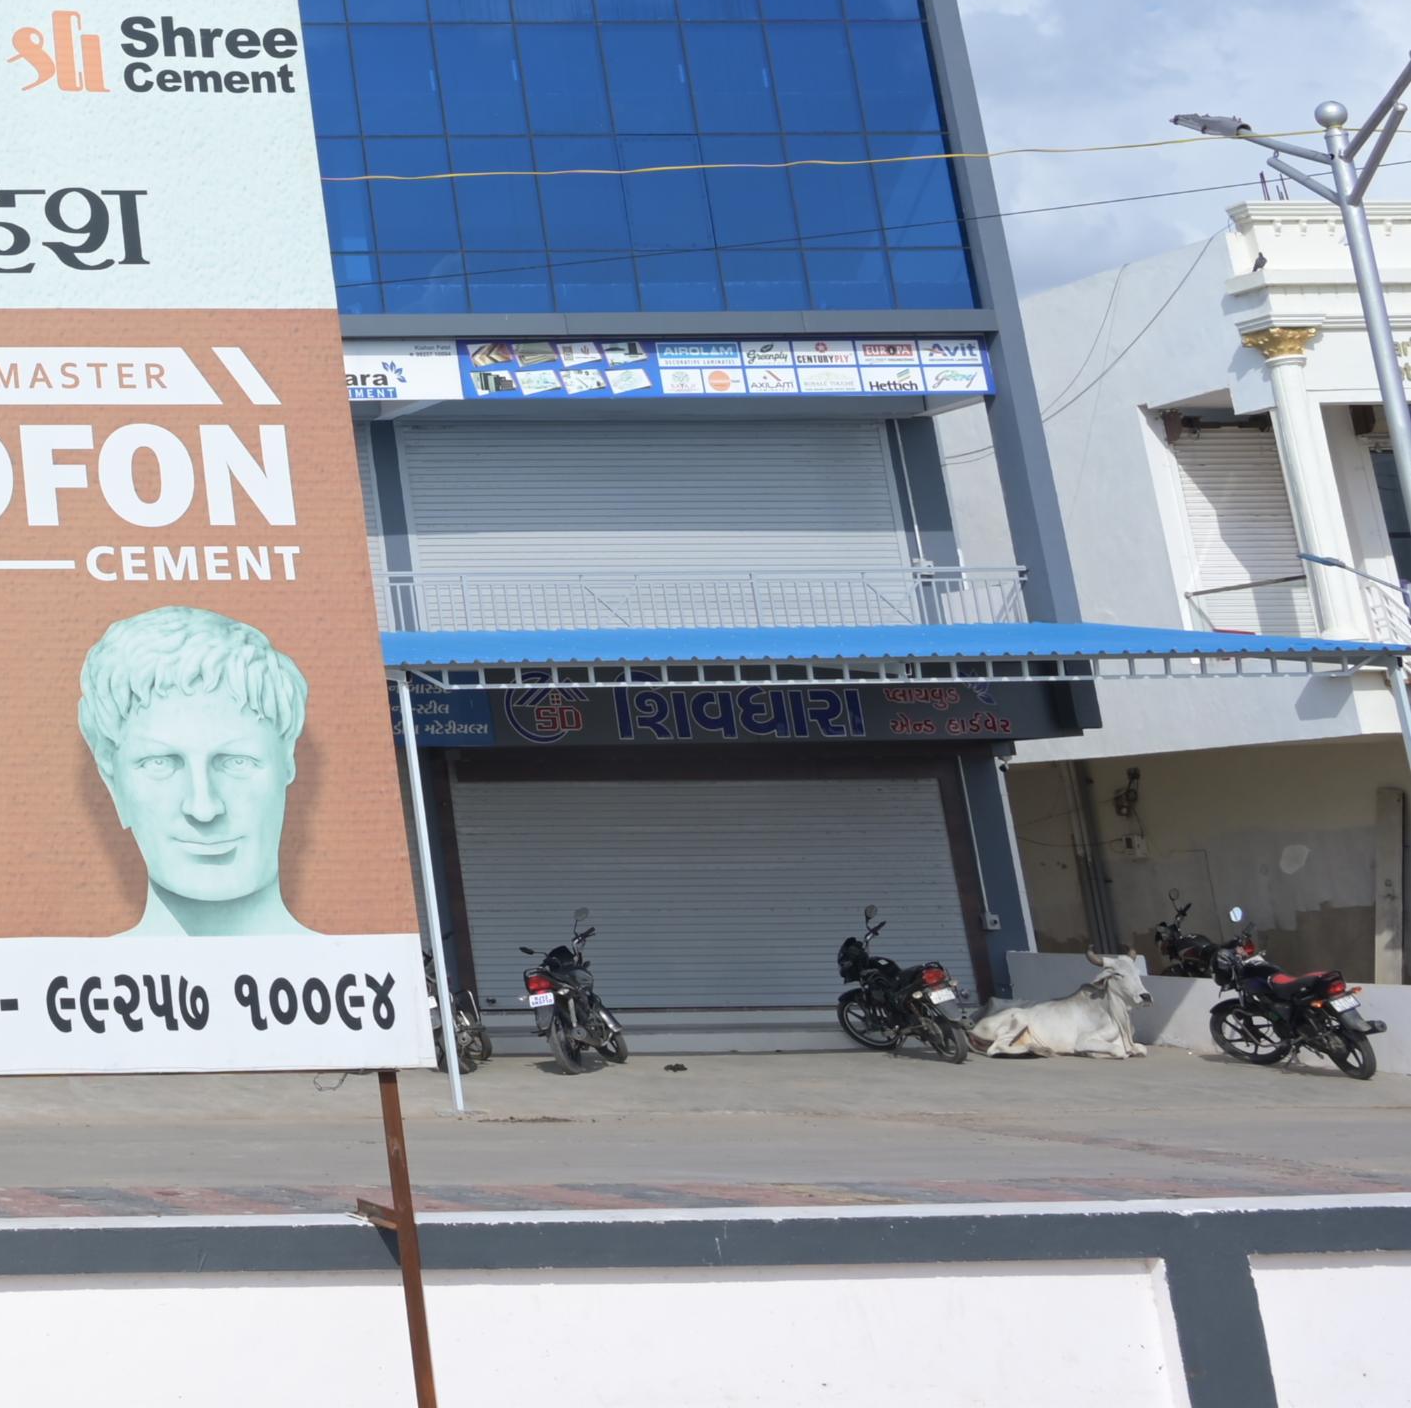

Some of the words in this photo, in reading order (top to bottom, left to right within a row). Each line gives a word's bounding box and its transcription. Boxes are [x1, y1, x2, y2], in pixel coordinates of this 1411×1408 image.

[120, 15, 299, 59] Shree
[122, 62, 296, 95] Cement
[663, 346, 734, 356] AIROLAM
[746, 349, 788, 365] Greenply
[928, 343, 977, 357] Avit
[797, 354, 849, 363] CENTURYPLY
[346, 373, 389, 386] ara
[869, 380, 919, 391] Hettich
[86, 545, 301, 582] CEMENT
[613, 669, 867, 740] શિવધારા
[534, 705, 583, 732] SD
[0, 998, 19, 1012] -
